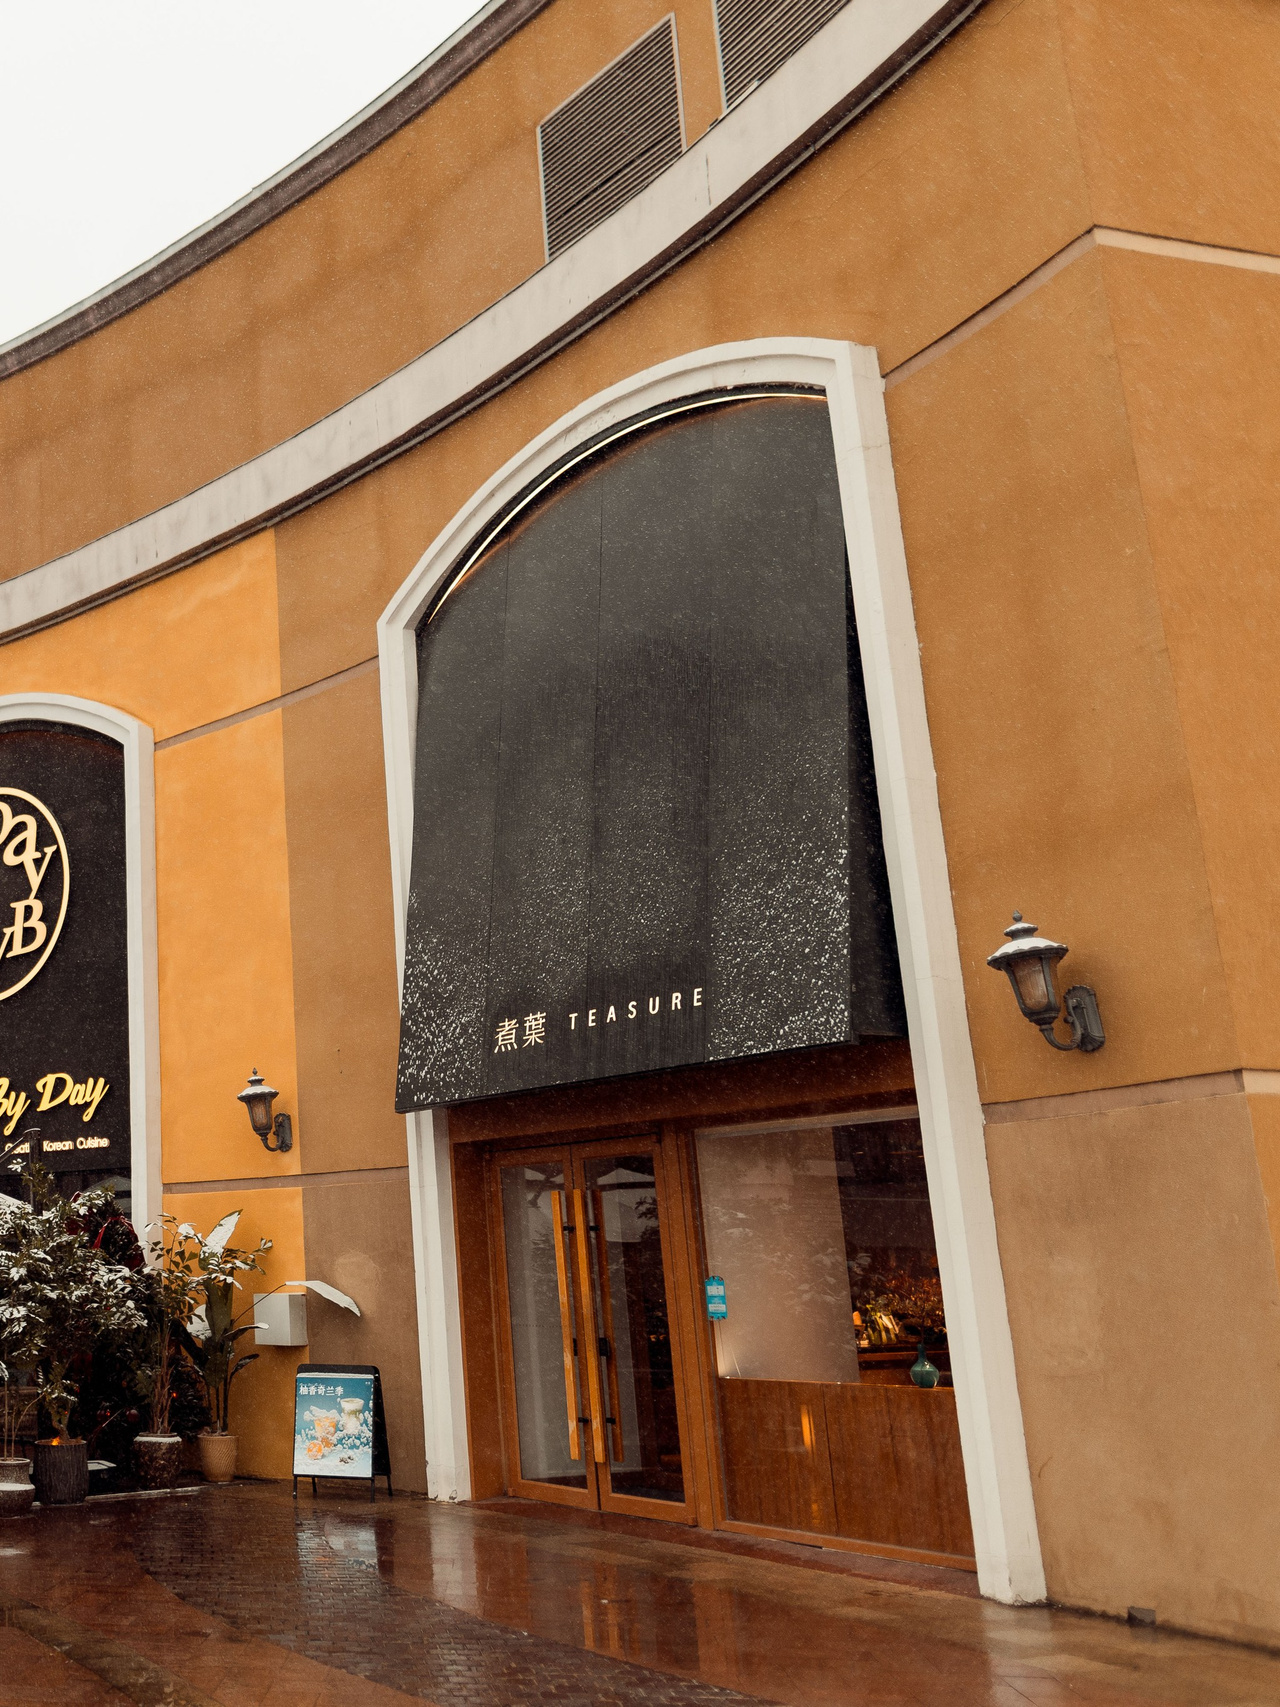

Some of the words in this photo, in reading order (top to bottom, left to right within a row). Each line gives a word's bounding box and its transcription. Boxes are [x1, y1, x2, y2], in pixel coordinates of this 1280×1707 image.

[569, 988, 703, 1030] TEASURE
[36, 1072, 109, 1122] Day
[42, 1140, 74, 1152] Korean
[76, 1137, 110, 1149] Cuisine
